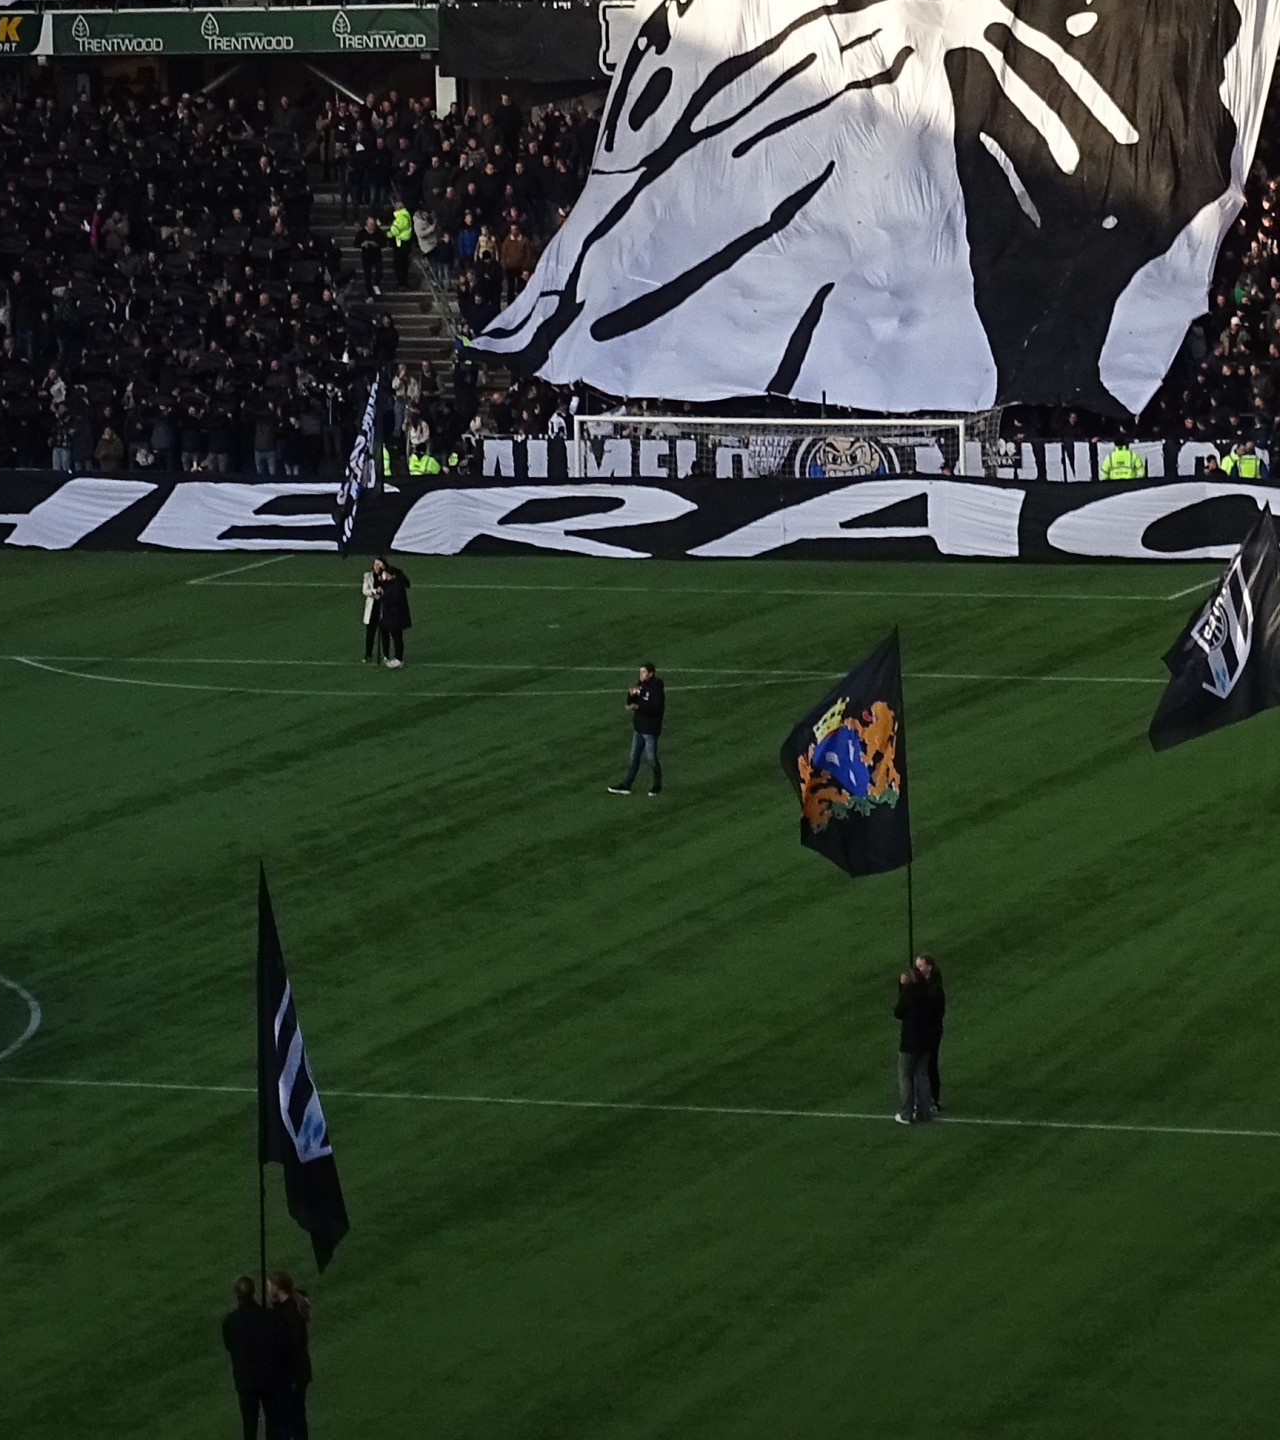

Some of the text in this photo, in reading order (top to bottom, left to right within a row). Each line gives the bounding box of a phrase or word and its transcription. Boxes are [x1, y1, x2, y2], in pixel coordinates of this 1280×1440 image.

[75, 36, 163, 52] TRENTWOOD
[204, 35, 295, 51] TRENTWOOD
[335, 33, 427, 49] TRENTWOOD
